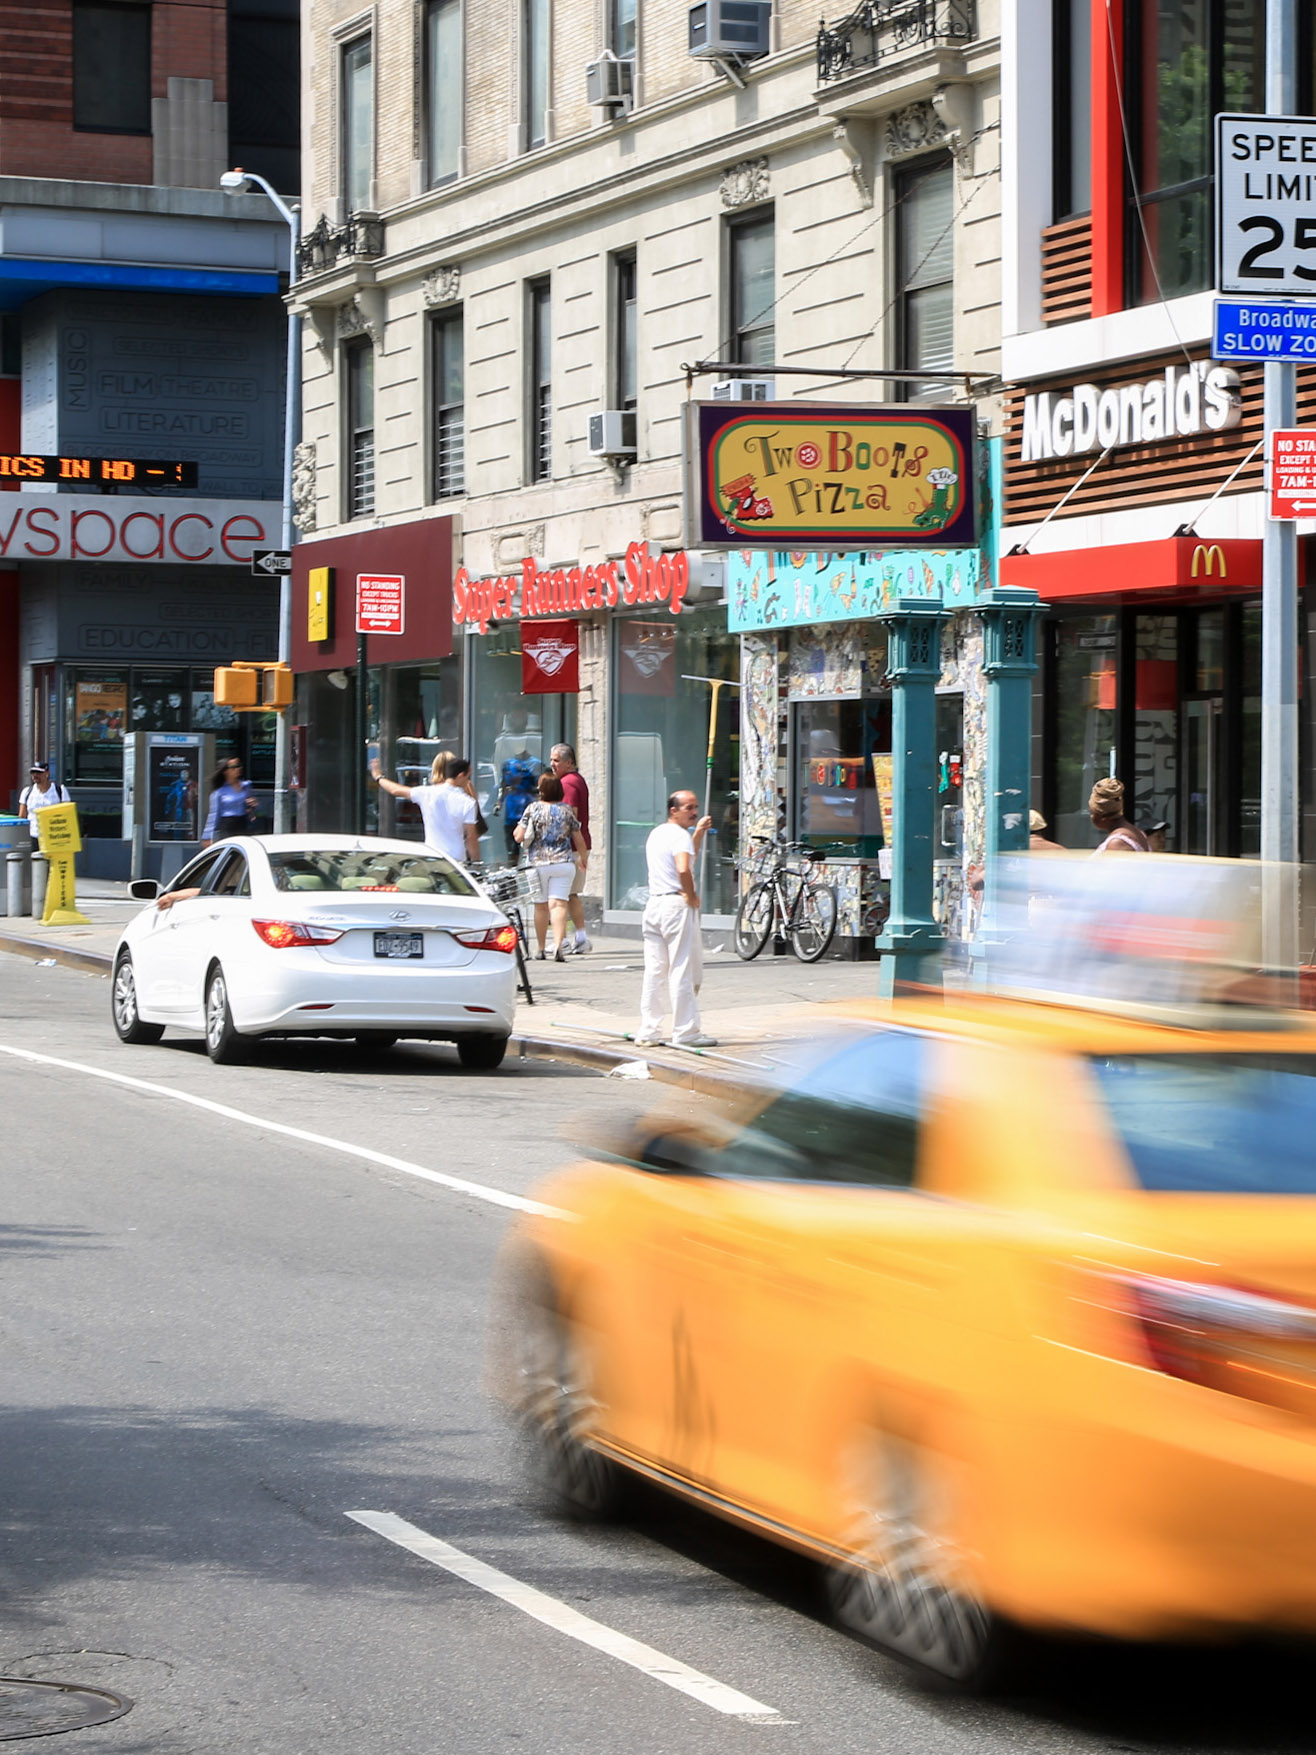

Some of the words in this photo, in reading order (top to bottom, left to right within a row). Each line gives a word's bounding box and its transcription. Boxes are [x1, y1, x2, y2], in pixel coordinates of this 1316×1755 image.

[1223, 333, 1283, 352] SLOW
[67, 331, 88, 408] MUSIC
[101, 375, 153, 394] FILM
[165, 378, 252, 398] THEATRE
[1021, 362, 1240, 461] McDonald's
[104, 412, 244, 435] LITERATURE
[1277, 440, 1293, 452] NO
[1280, 455, 1312, 464] EXCEPT
[58, 459, 90, 479] IN
[102, 461, 136, 481] HD
[265, 558, 286, 568] ONE
[453, 567, 517, 635] Super
[519, 556, 619, 616] Runners
[623, 541, 689, 614] Shop
[86, 630, 228, 649] EDUCATION
